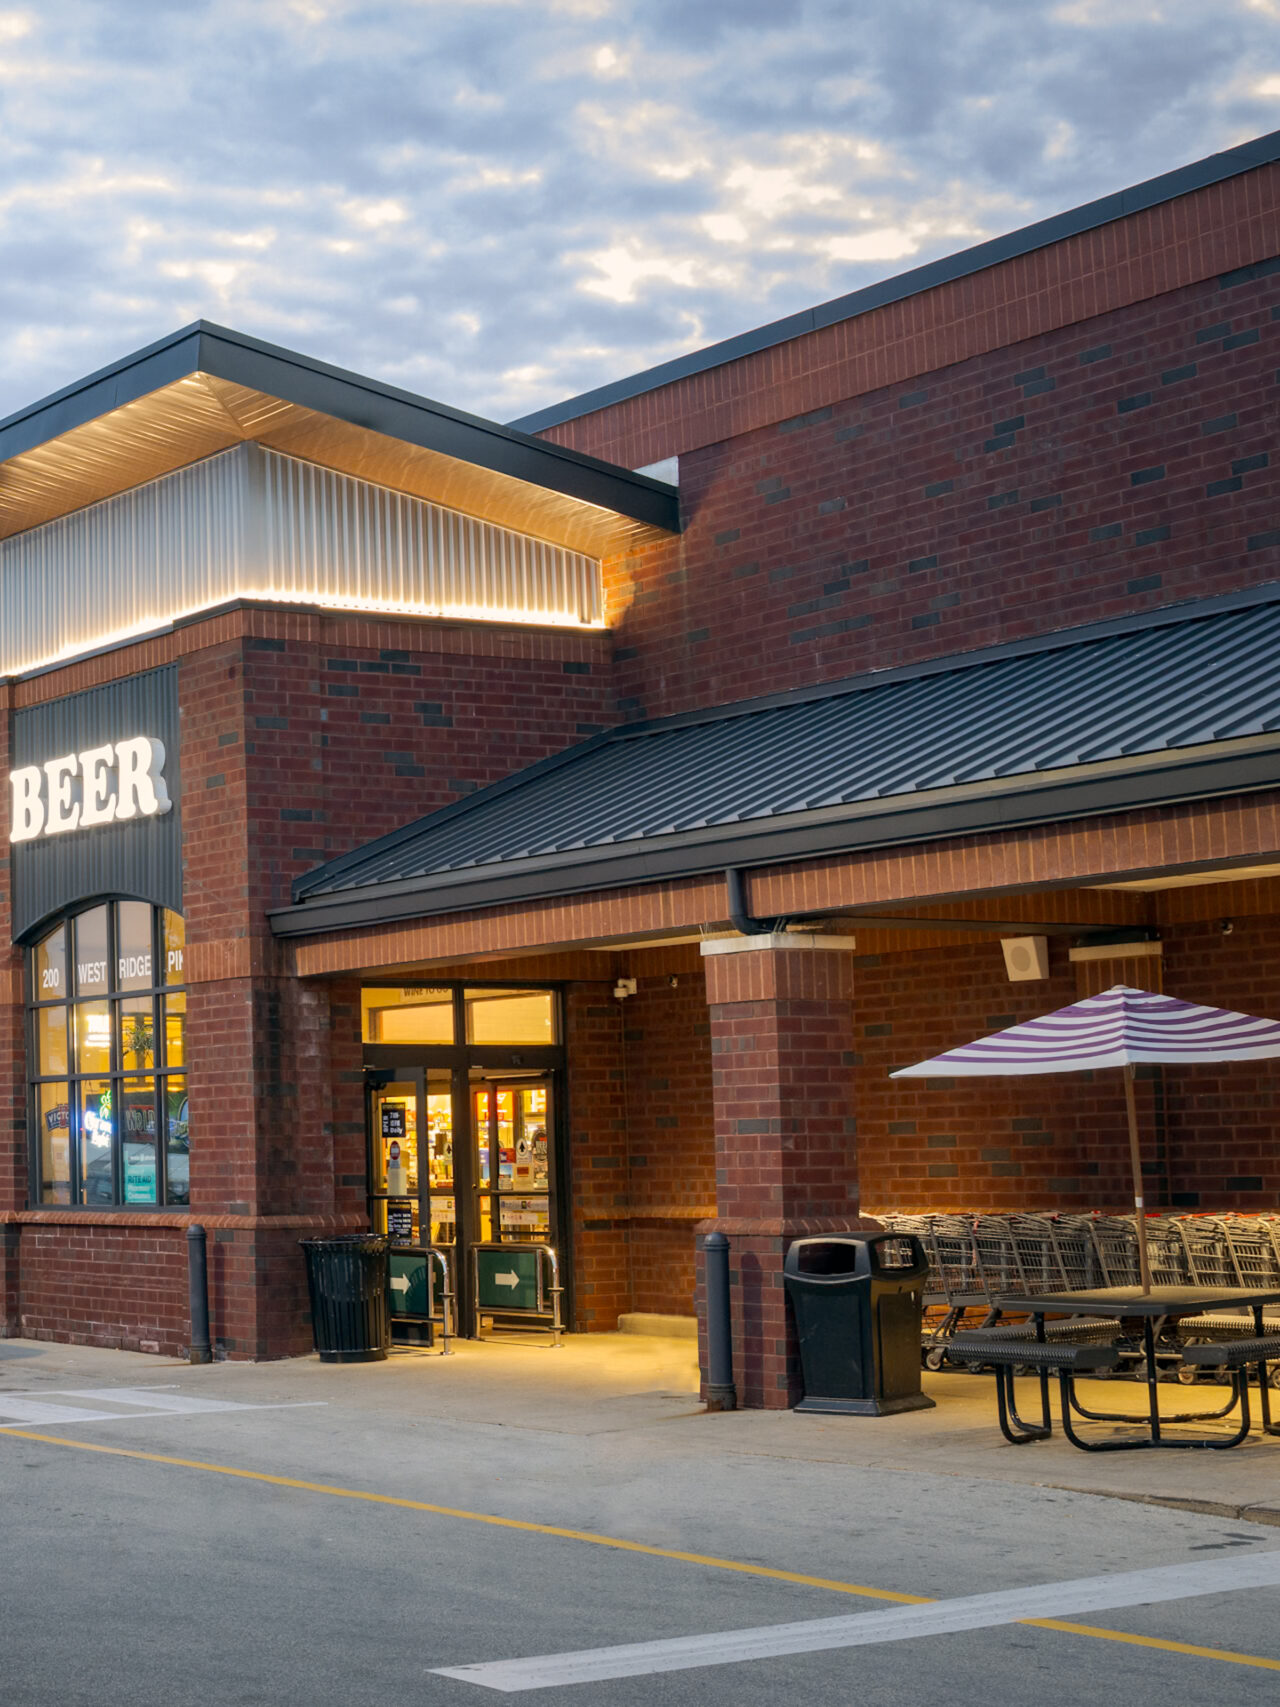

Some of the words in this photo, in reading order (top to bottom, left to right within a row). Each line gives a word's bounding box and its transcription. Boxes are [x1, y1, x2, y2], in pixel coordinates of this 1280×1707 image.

[10, 737, 168, 843] BEER
[43, 968, 59, 988] 200
[78, 962, 107, 984] WEST
[119, 955, 152, 979] RIDGE
